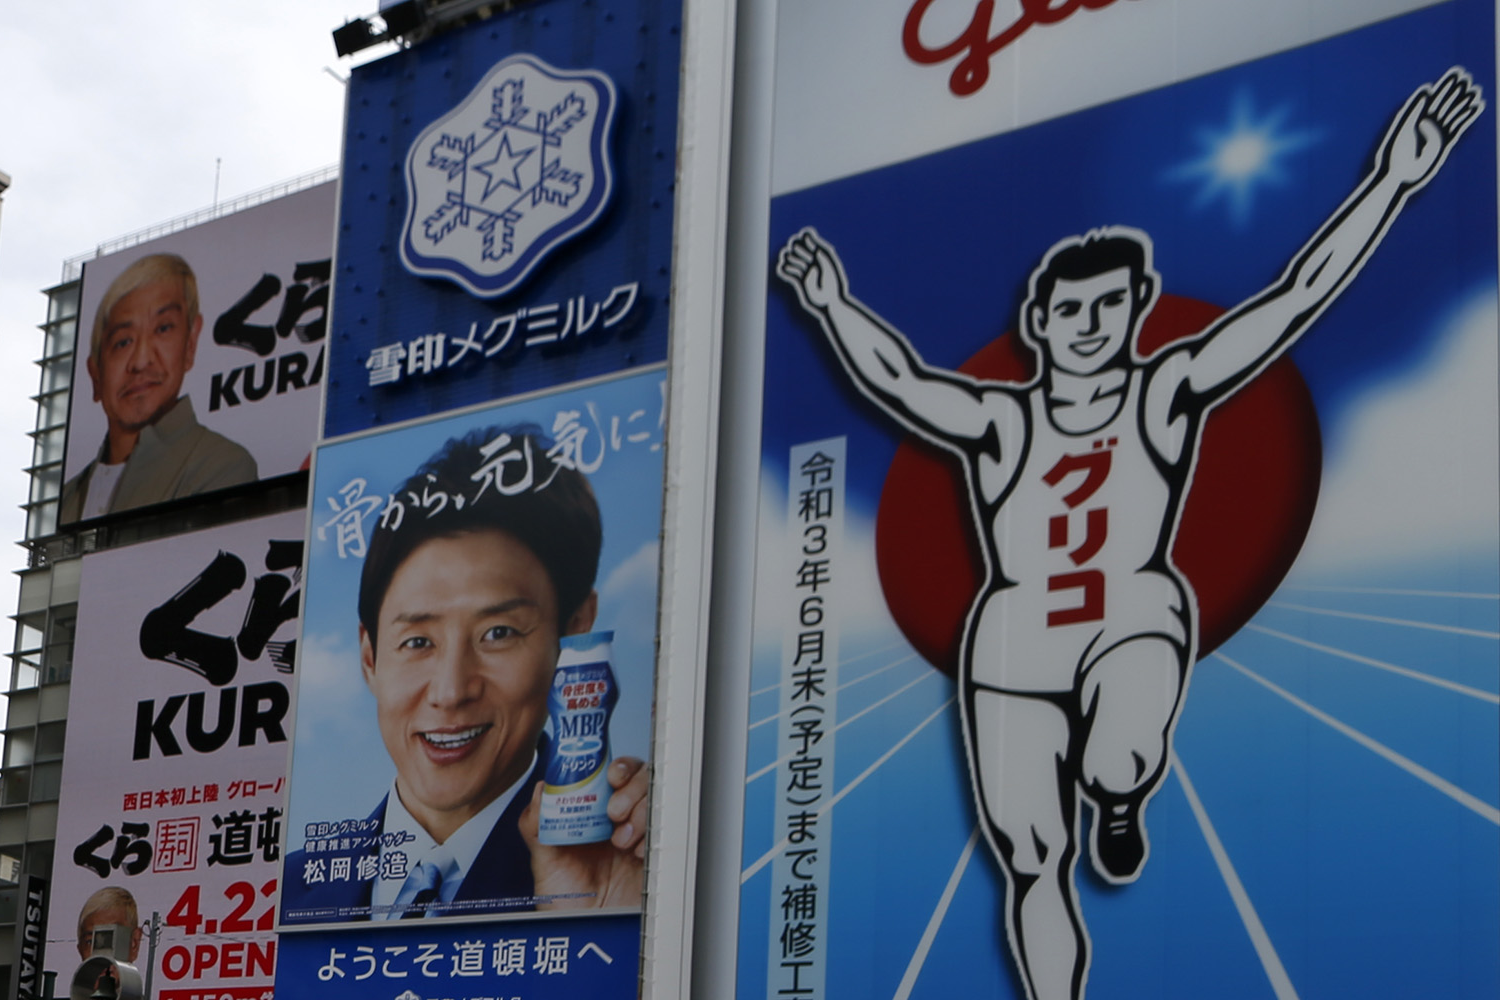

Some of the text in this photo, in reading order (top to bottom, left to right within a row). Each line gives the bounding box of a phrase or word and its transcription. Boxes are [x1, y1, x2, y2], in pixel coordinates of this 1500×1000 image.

[366, 282, 639, 387] 雪印メグミルク
[1041, 436, 1118, 628] グリコ
[566, 695, 601, 711] 高める
[560, 711, 604, 739] MBP
[561, 758, 596, 772] ドリンク
[123, 783, 219, 812] 西日本初上陸
[304, 832, 416, 853] 健康推進アンバサダー
[305, 818, 381, 838] 雪印メグミルク
[303, 852, 409, 885] 松岡修造
[162, 941, 276, 981] OPEN
[317, 936, 613, 983] ようこそ道頓堀へ
